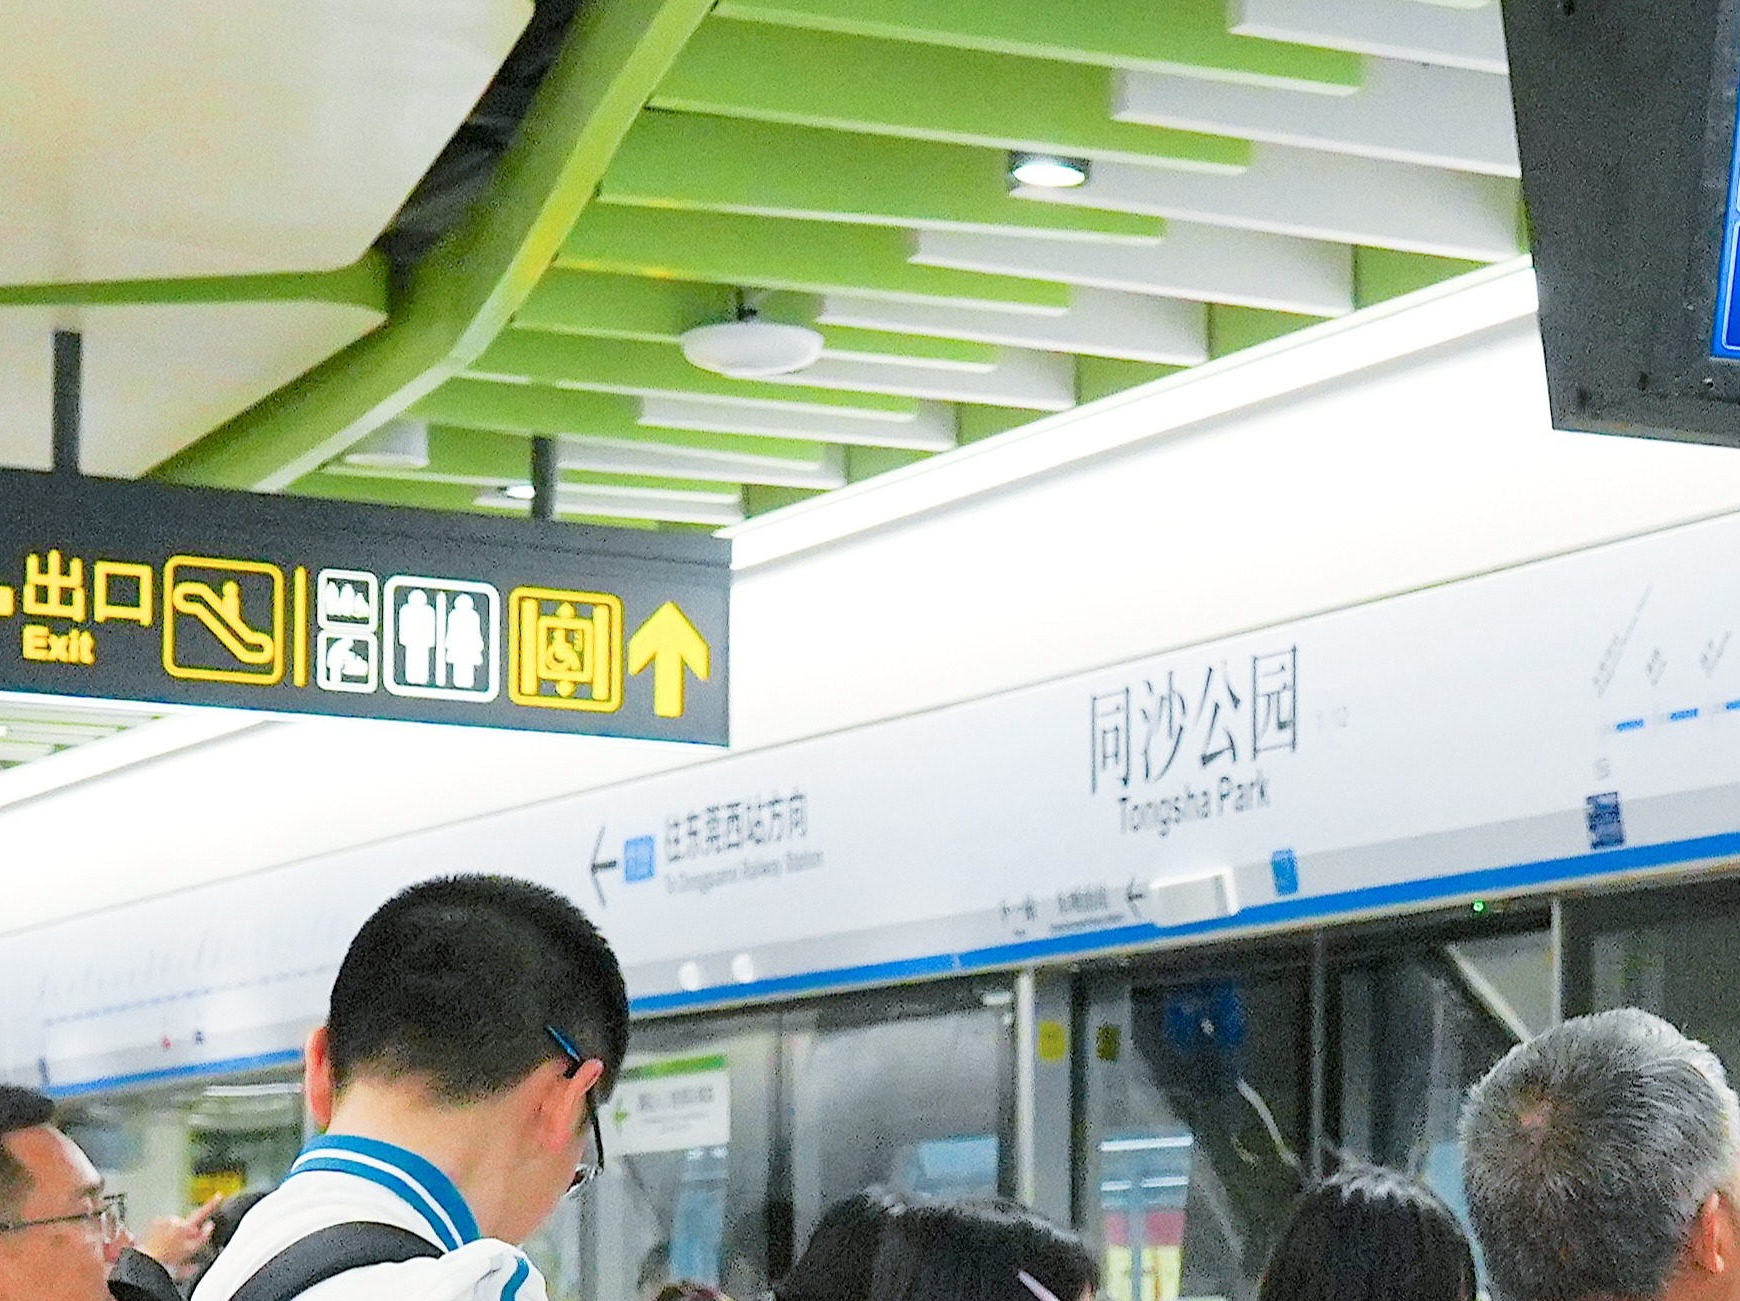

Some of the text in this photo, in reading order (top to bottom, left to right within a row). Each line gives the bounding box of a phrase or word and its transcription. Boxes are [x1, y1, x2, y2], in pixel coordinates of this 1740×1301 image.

[23, 549, 153, 628] 出口
[23, 624, 96, 666] Exit
[1090, 643, 1299, 796] 同沙公园
[665, 786, 809, 863] 往东莞西站方向
[1119, 767, 1270, 837] Tongsha Park
